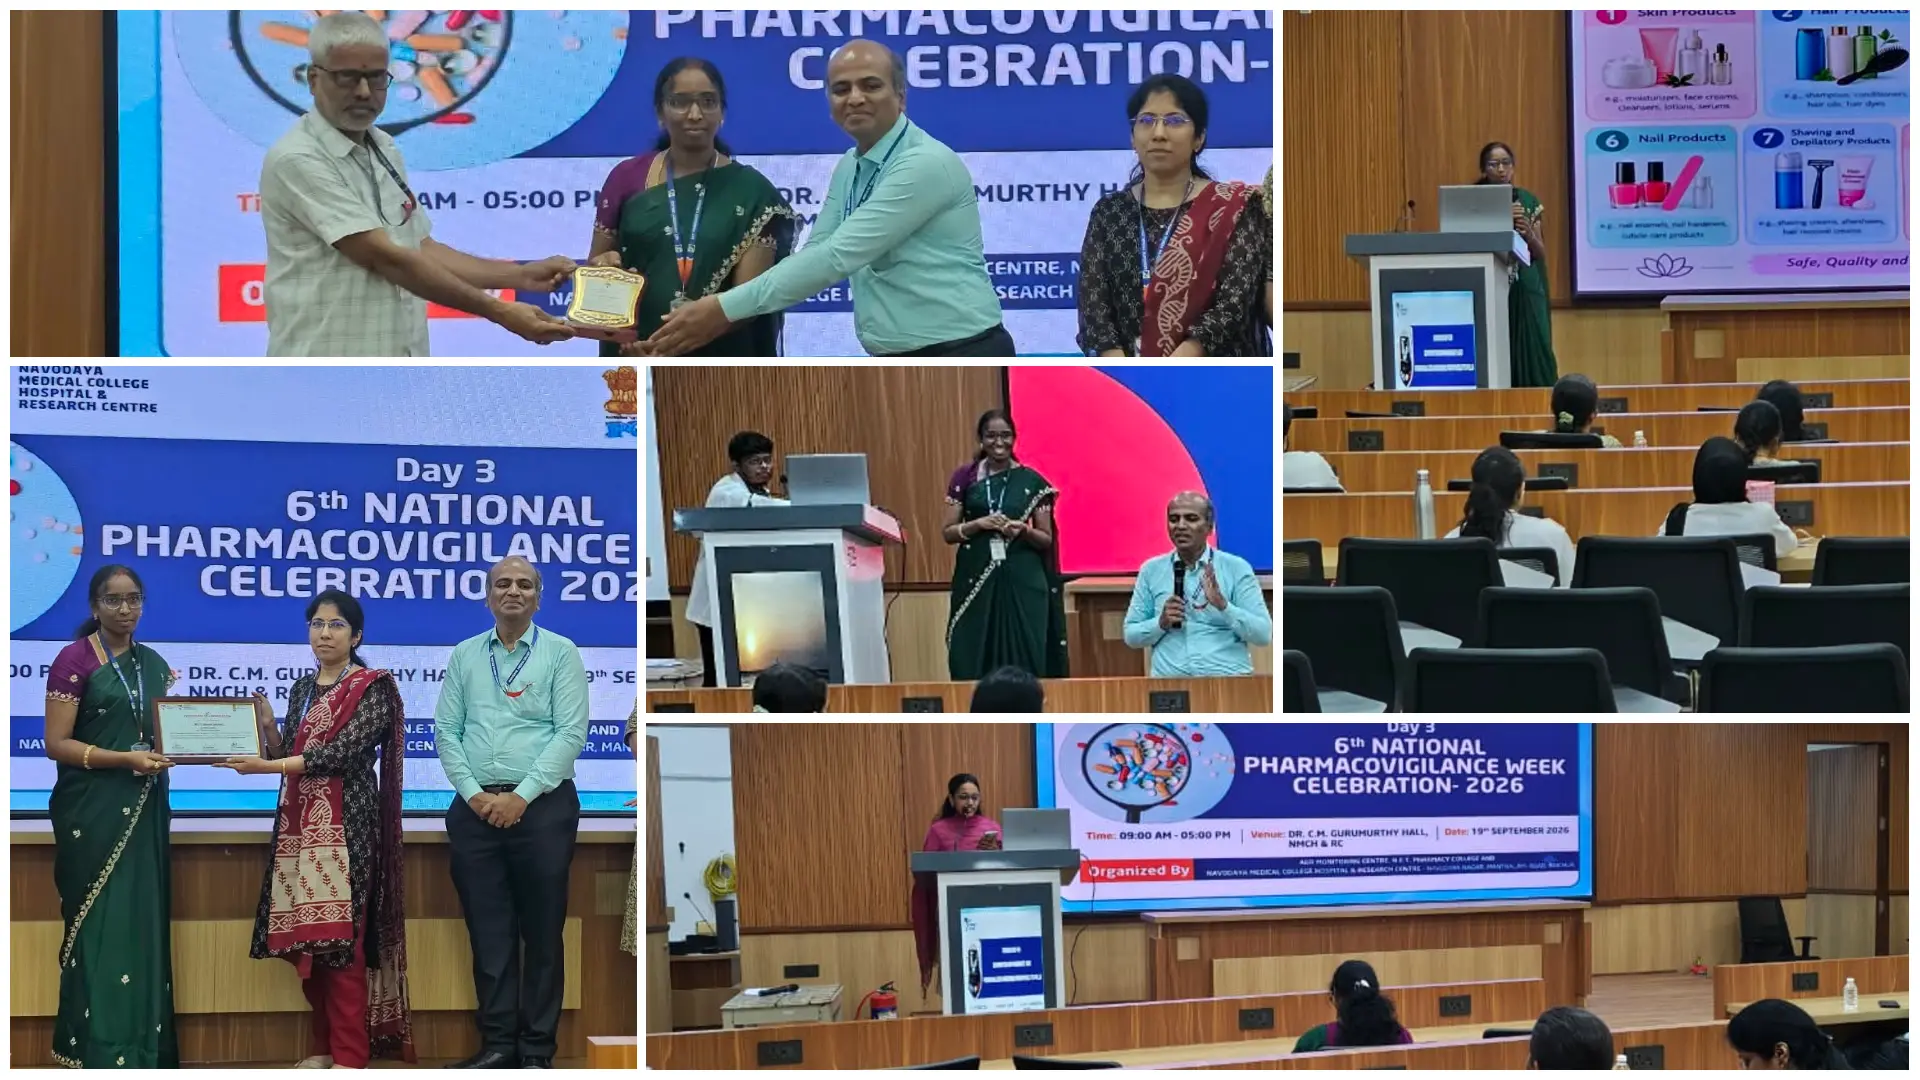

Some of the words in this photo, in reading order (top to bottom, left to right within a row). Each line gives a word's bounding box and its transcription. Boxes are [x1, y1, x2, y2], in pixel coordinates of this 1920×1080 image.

[1606, 10, 1615, 21] 1
[655, 10, 1273, 38] PHARMACOVIGILA
[788, 41, 1269, 89] CEBRATION-
[1605, 134, 1619, 148] 6
[1639, 133, 1664, 142] Nail
[1668, 133, 1726, 142] Products
[1762, 132, 1775, 144] 7
[1791, 128, 1832, 137] Shaving
[1835, 128, 1855, 136] and
[1791, 138, 1844, 146] Depilatory
[418, 191, 456, 209] AM
[483, 190, 564, 209] 05:00
[975, 183, 1089, 202] MURTHY
[985, 260, 1064, 275] CENTRE,
[1787, 257, 1821, 269] Safe,
[1826, 256, 1878, 268] Quality
[1881, 255, 1909, 265] and
[992, 285, 1073, 299] SEARCH
[18, 366, 103, 375] NAVODAYA
[18, 376, 82, 387] MEDICAL
[87, 378, 149, 389] COLLEGE
[18, 388, 92, 399] HOSPITAL
[97, 390, 107, 399] &
[18, 400, 96, 411] RESEARCH
[101, 402, 157, 413] CENTRE
[396, 457, 464, 488] Day
[475, 459, 496, 483] 3
[286, 490, 348, 522] 6th
[364, 492, 604, 526] NATIONAL
[102, 524, 631, 564] PHARMACOVIGILANCE
[200, 565, 543, 601] CELEBRATIO
[189, 666, 222, 680] DR.
[229, 667, 268, 681] C.M.
[586, 670, 607, 683] 9th
[190, 685, 247, 697] NMCH
[256, 686, 268, 699] &
[275, 687, 288, 699] R
[405, 724, 436, 734] N.E.T
[589, 724, 619, 736] AND
[1387, 723, 1419, 736] Day
[1426, 723, 1435, 733] 3
[406, 741, 434, 751] CEN
[1334, 737, 1365, 754] 6th
[1372, 738, 1486, 755] NATIONAL
[1243, 756, 1499, 775] PHARMACOVIGILANCE
[1505, 758, 1566, 775] WEEK
[1293, 777, 1459, 794] CELEBRATION-
[1466, 777, 1524, 794] 2026
[1086, 831, 1116, 840] Time:
[1119, 831, 1152, 840] 09:00
[1154, 831, 1172, 840] AM
[1181, 831, 1212, 840] 05:00
[1215, 831, 1231, 839] PM
[1251, 830, 1285, 839] Venue:
[1288, 830, 1305, 838] DR.
[1308, 830, 1328, 838] C.M.
[1331, 829, 1399, 838] GURUMURTHY
[1401, 828, 1429, 837] HALL,
[1444, 827, 1469, 836] Date:
[1491, 827, 1544, 835] SEPTEMBER
[1546, 826, 1570, 834] 2026
[1288, 840, 1318, 848] NMCH
[1320, 840, 1328, 848] &
[1331, 839, 1344, 847] RC
[1089, 864, 1166, 879] Organized
[1171, 864, 1190, 877] By
